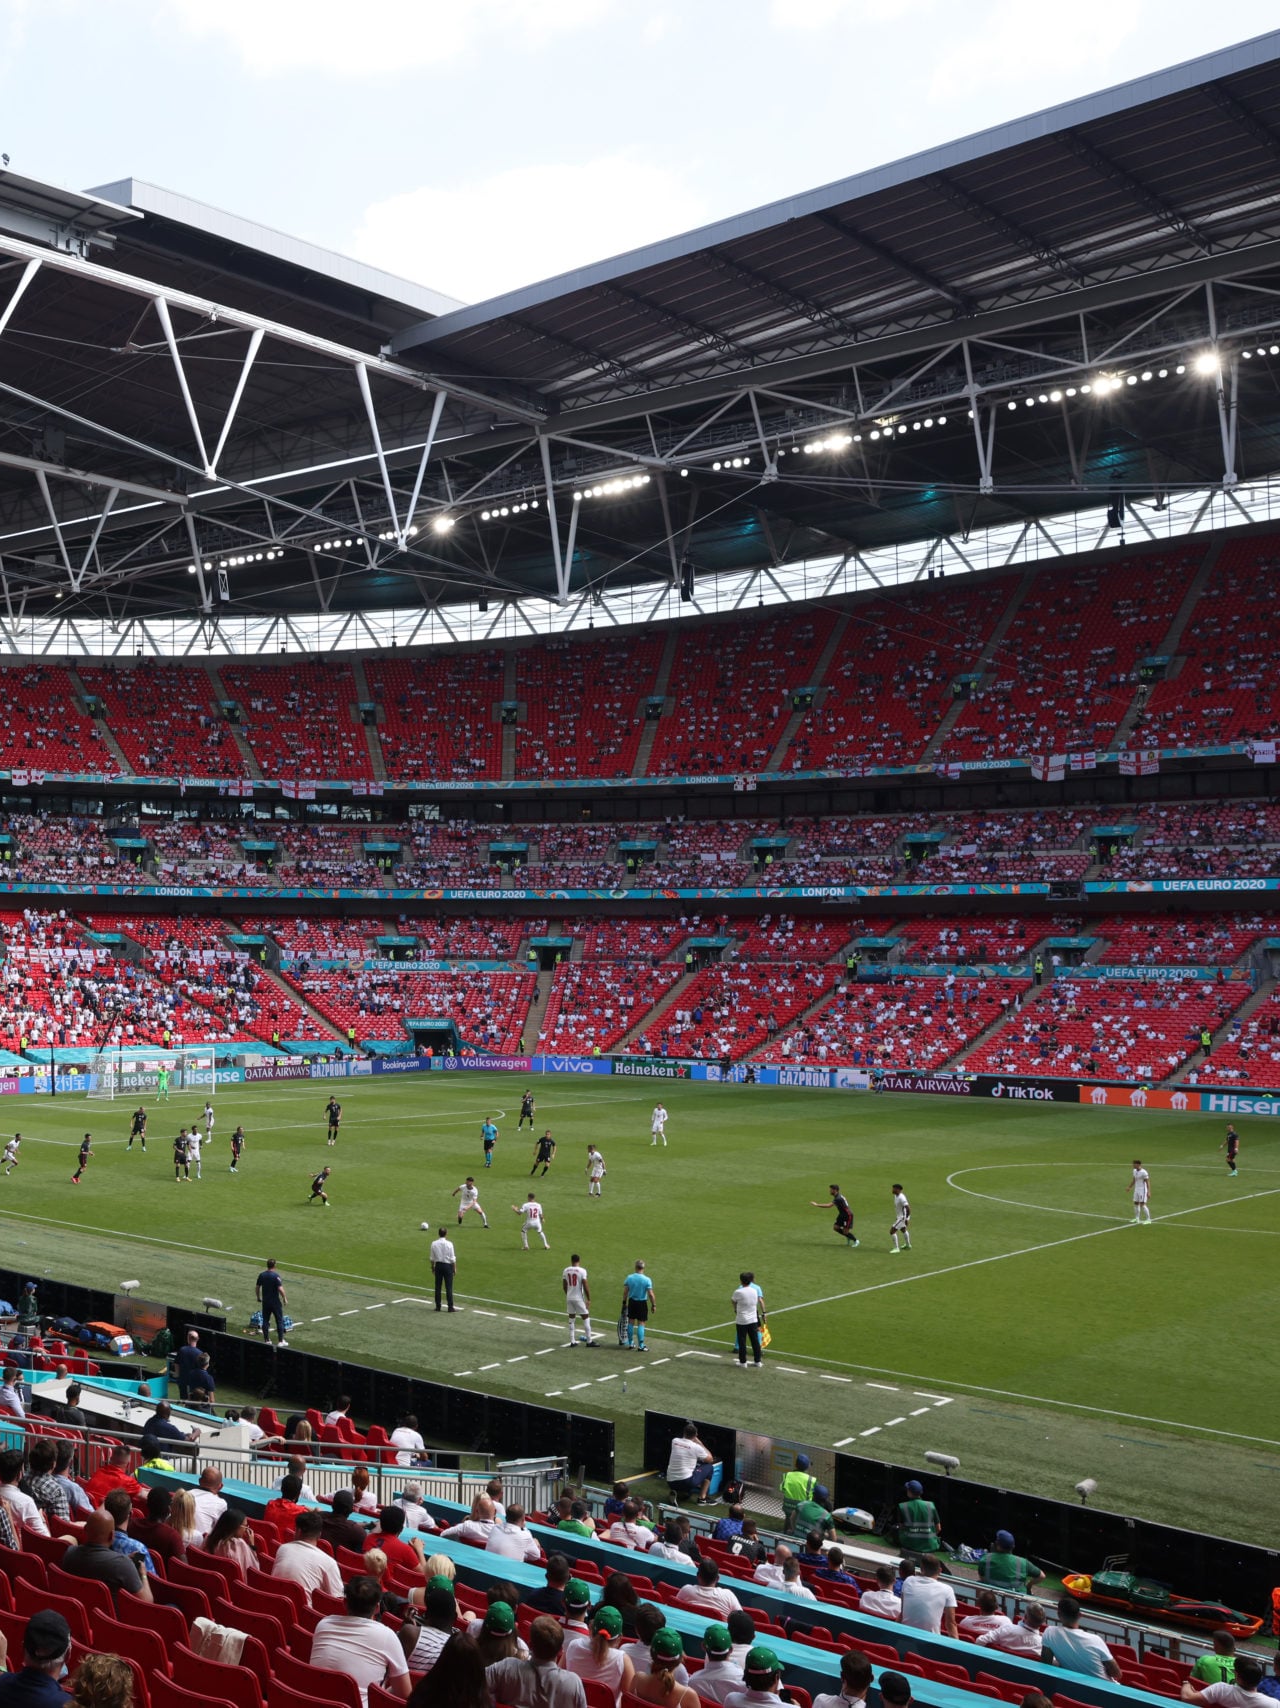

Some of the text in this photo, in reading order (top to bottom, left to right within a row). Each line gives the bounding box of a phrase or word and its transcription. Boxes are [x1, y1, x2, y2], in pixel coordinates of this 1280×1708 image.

[965, 760, 1010, 770] EURO 2020
[186, 778, 216, 787] LONDON
[415, 781, 474, 789] UEFA EURO 2020
[686, 776, 719, 784] LONDON
[1162, 879, 1266, 891] UEFA EURO 2020
[155, 887, 193, 897] LONDON
[450, 890, 526, 899] UEFA EURO 2020
[802, 887, 845, 897] LONDON
[395, 960, 418, 970] EURO
[419, 960, 440, 970] 2020
[1106, 968, 1198, 978] UEFA EURO 2020
[382, 1059, 420, 1071] Booking.com
[461, 1057, 528, 1069] Volkswagen
[552, 1058, 594, 1073] vivo
[244, 1065, 310, 1079] QATAR AIRWAYS
[311, 1063, 346, 1078] GAZPROM
[615, 1062, 674, 1077] Heineken
[103, 1071, 158, 1088] Heneken
[183, 1068, 240, 1085] Hisense
[779, 1071, 830, 1087] GAZPROM
[914, 1079, 970, 1093] AIRWAYS
[1007, 1085, 1054, 1100] TikTok
[529, 1208, 538, 1219] 12
[567, 1273, 578, 1287] 18
